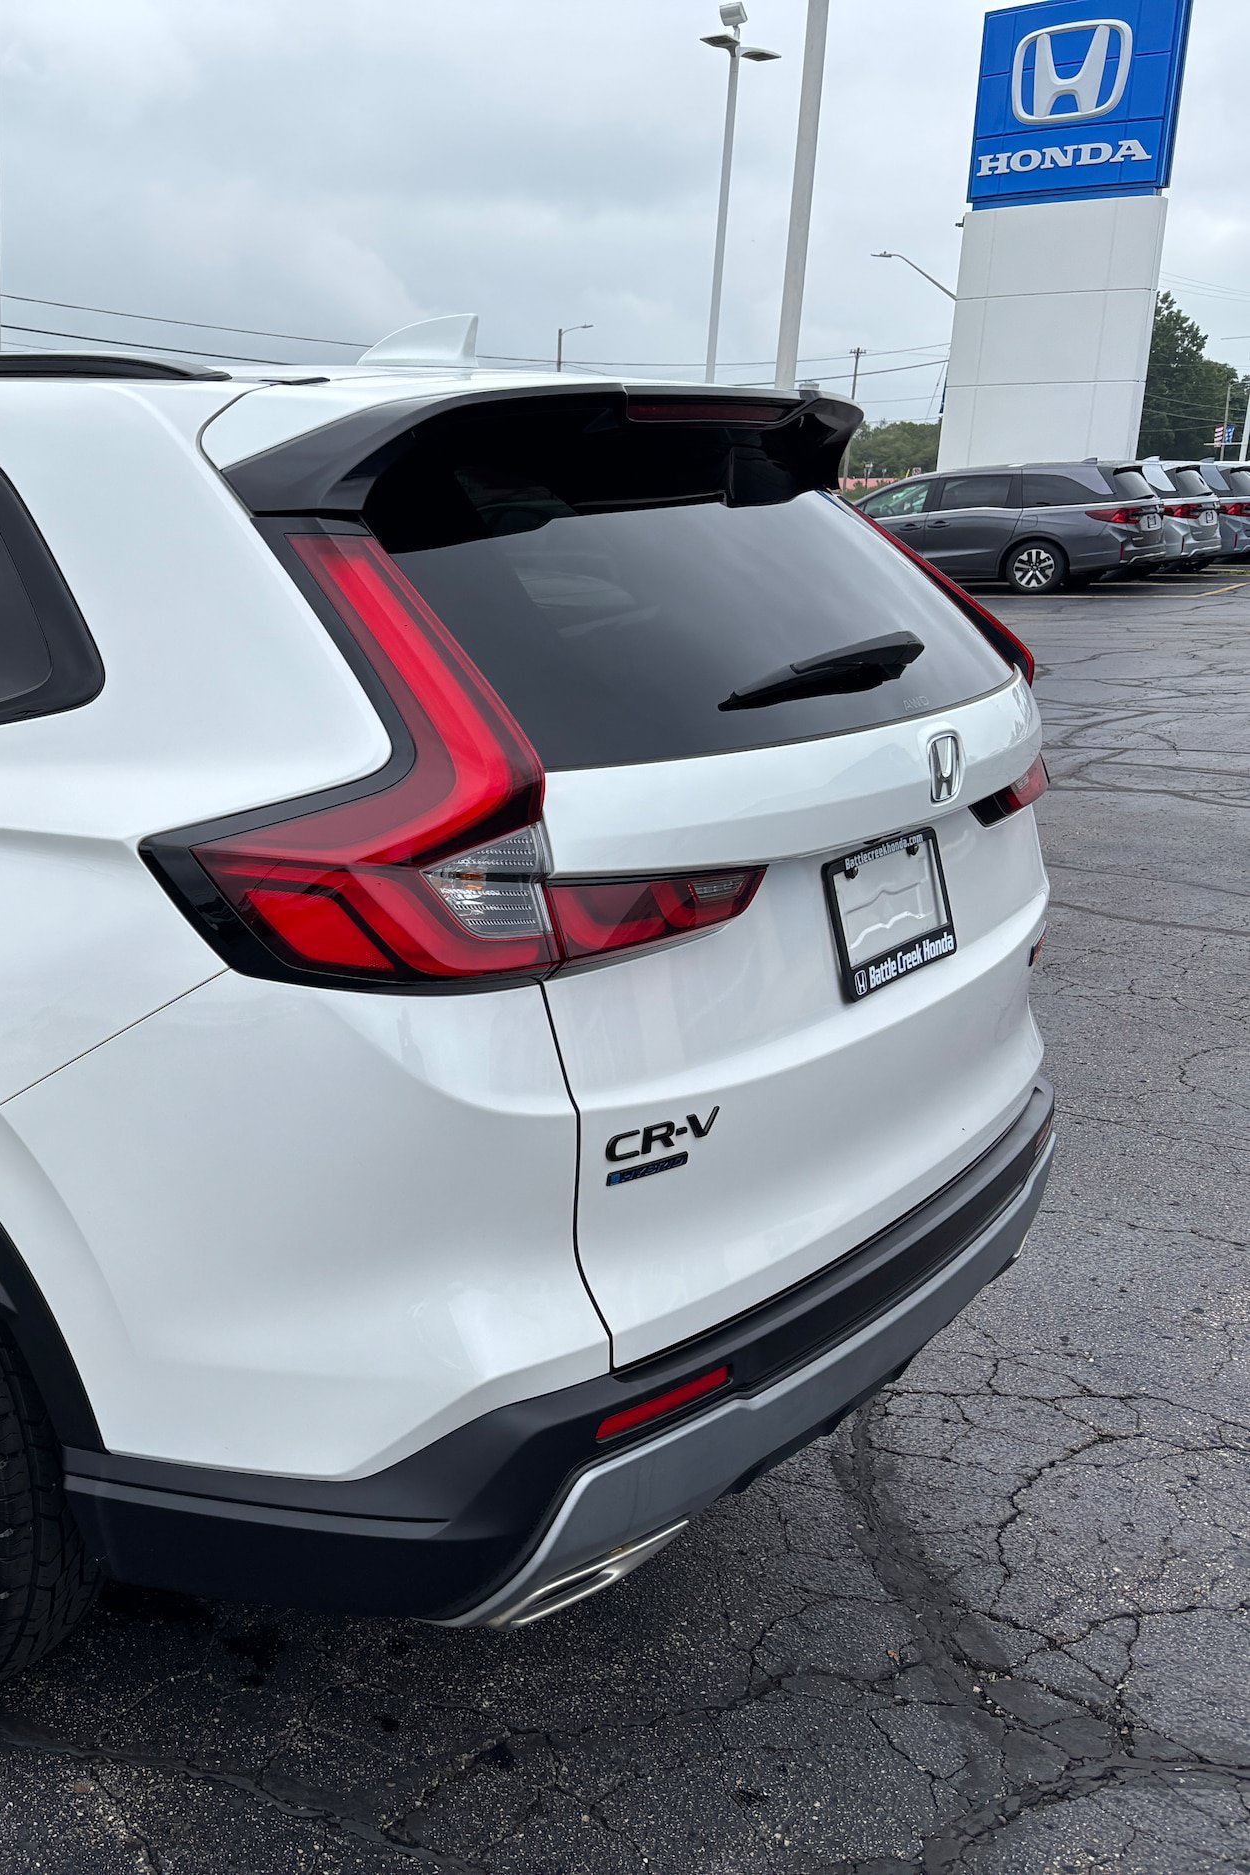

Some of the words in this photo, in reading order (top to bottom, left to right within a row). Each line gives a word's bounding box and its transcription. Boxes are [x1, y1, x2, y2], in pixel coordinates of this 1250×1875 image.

[976, 139, 1152, 177] HONDA
[902, 695, 930, 712] AWD
[845, 833, 924, 871] Battlecreekhonda.com
[868, 957, 898, 989] Battle
[897, 943, 924, 970] Creek
[923, 932, 955, 961] Honda
[605, 1105, 720, 1162] CR-V
